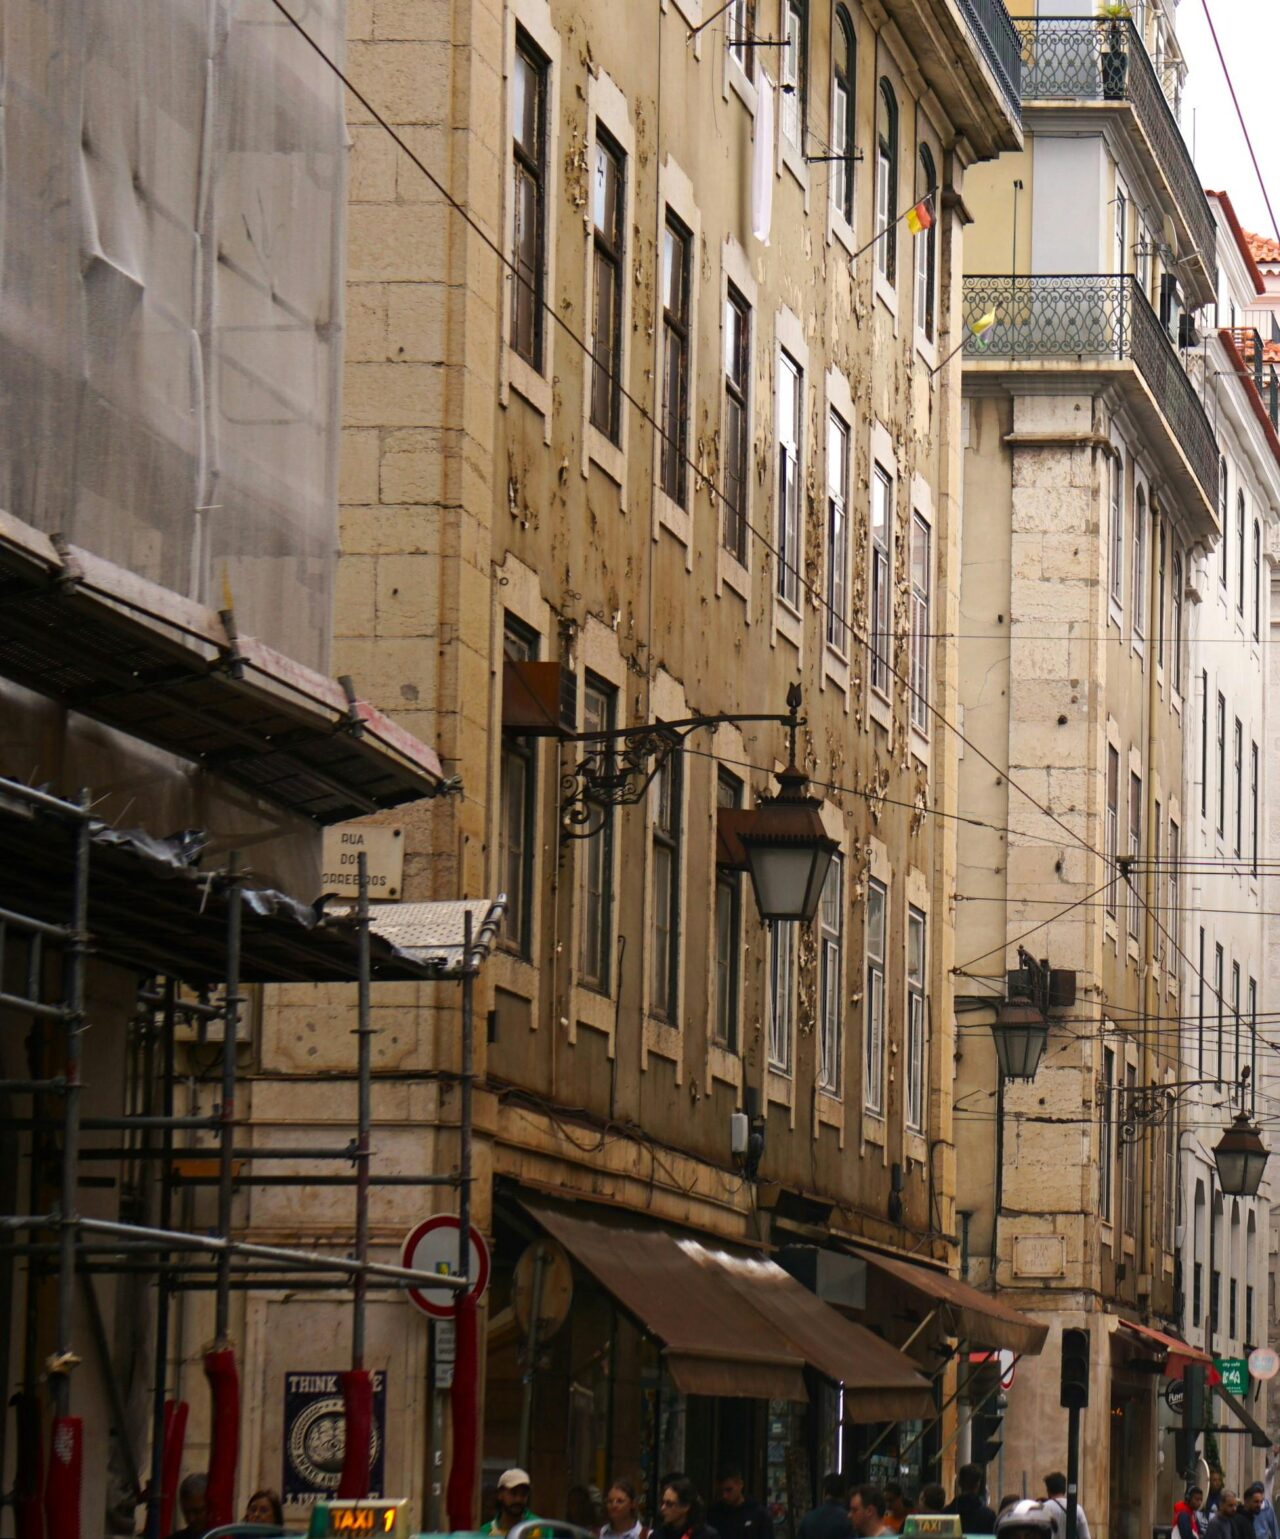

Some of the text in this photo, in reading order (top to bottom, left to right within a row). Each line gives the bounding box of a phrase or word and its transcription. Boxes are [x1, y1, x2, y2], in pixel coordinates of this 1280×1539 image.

[341, 833, 365, 845] RUA
[288, 1375, 338, 1393] THINK
[331, 1507, 396, 1533] TAXI 1
[916, 1520, 941, 1533] TAXI
